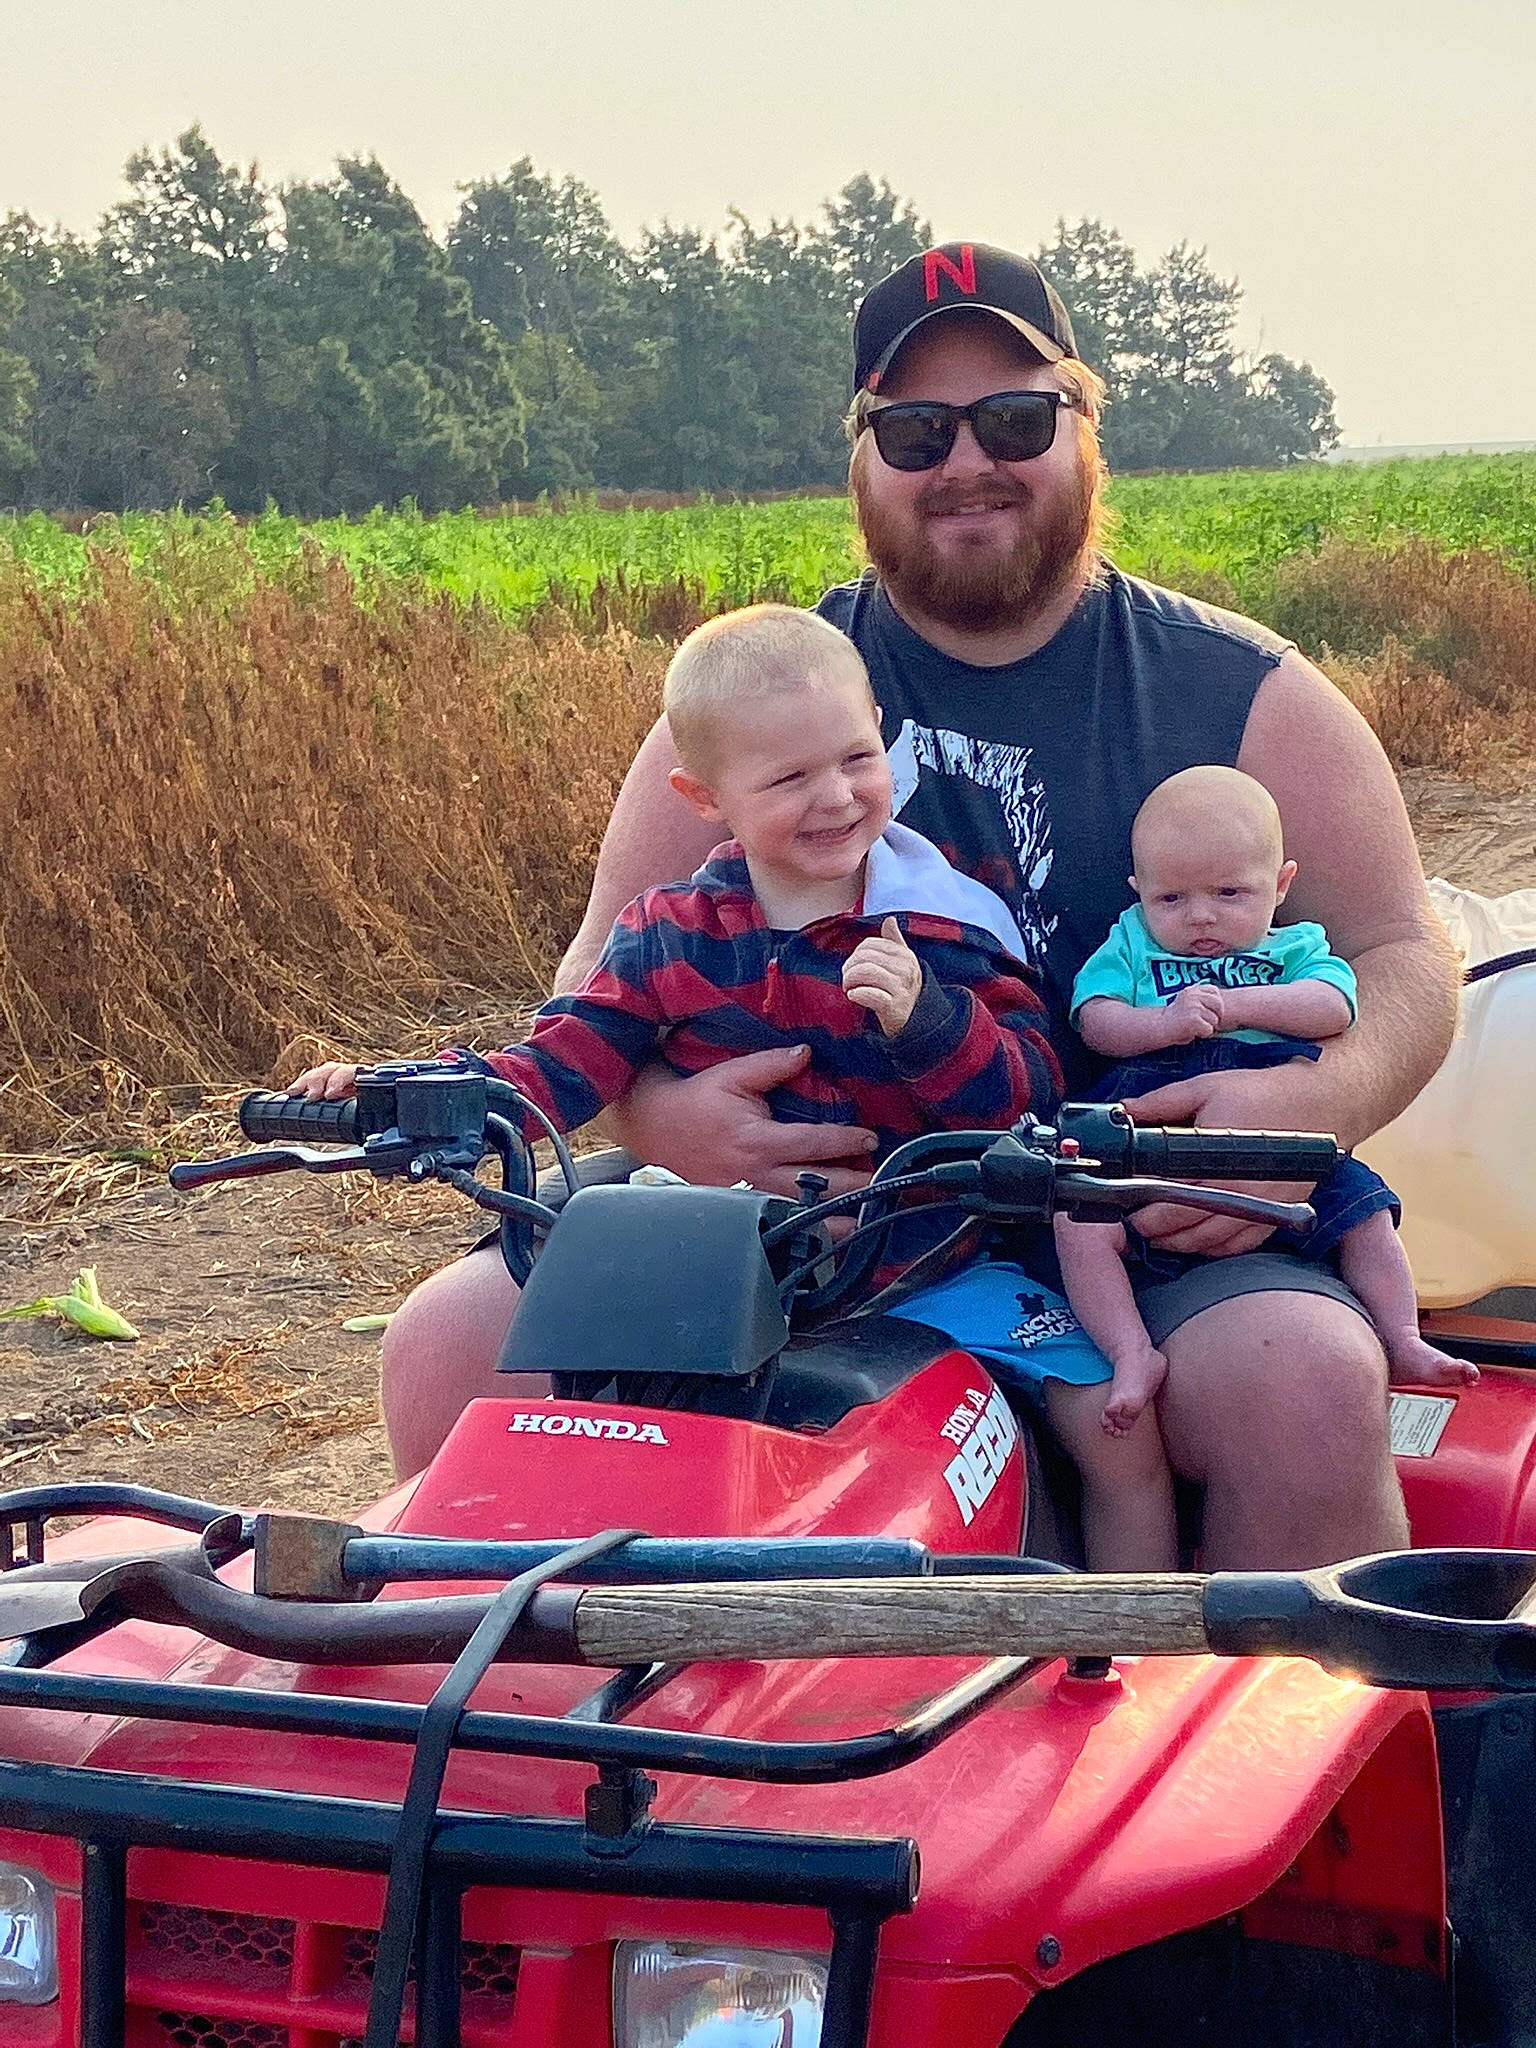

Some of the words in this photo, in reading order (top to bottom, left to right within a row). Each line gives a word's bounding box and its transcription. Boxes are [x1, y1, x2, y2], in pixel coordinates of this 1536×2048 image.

[924, 244, 977, 302] N
[507, 1413, 669, 1445] HONDA
[940, 1388, 988, 1446] HONA
